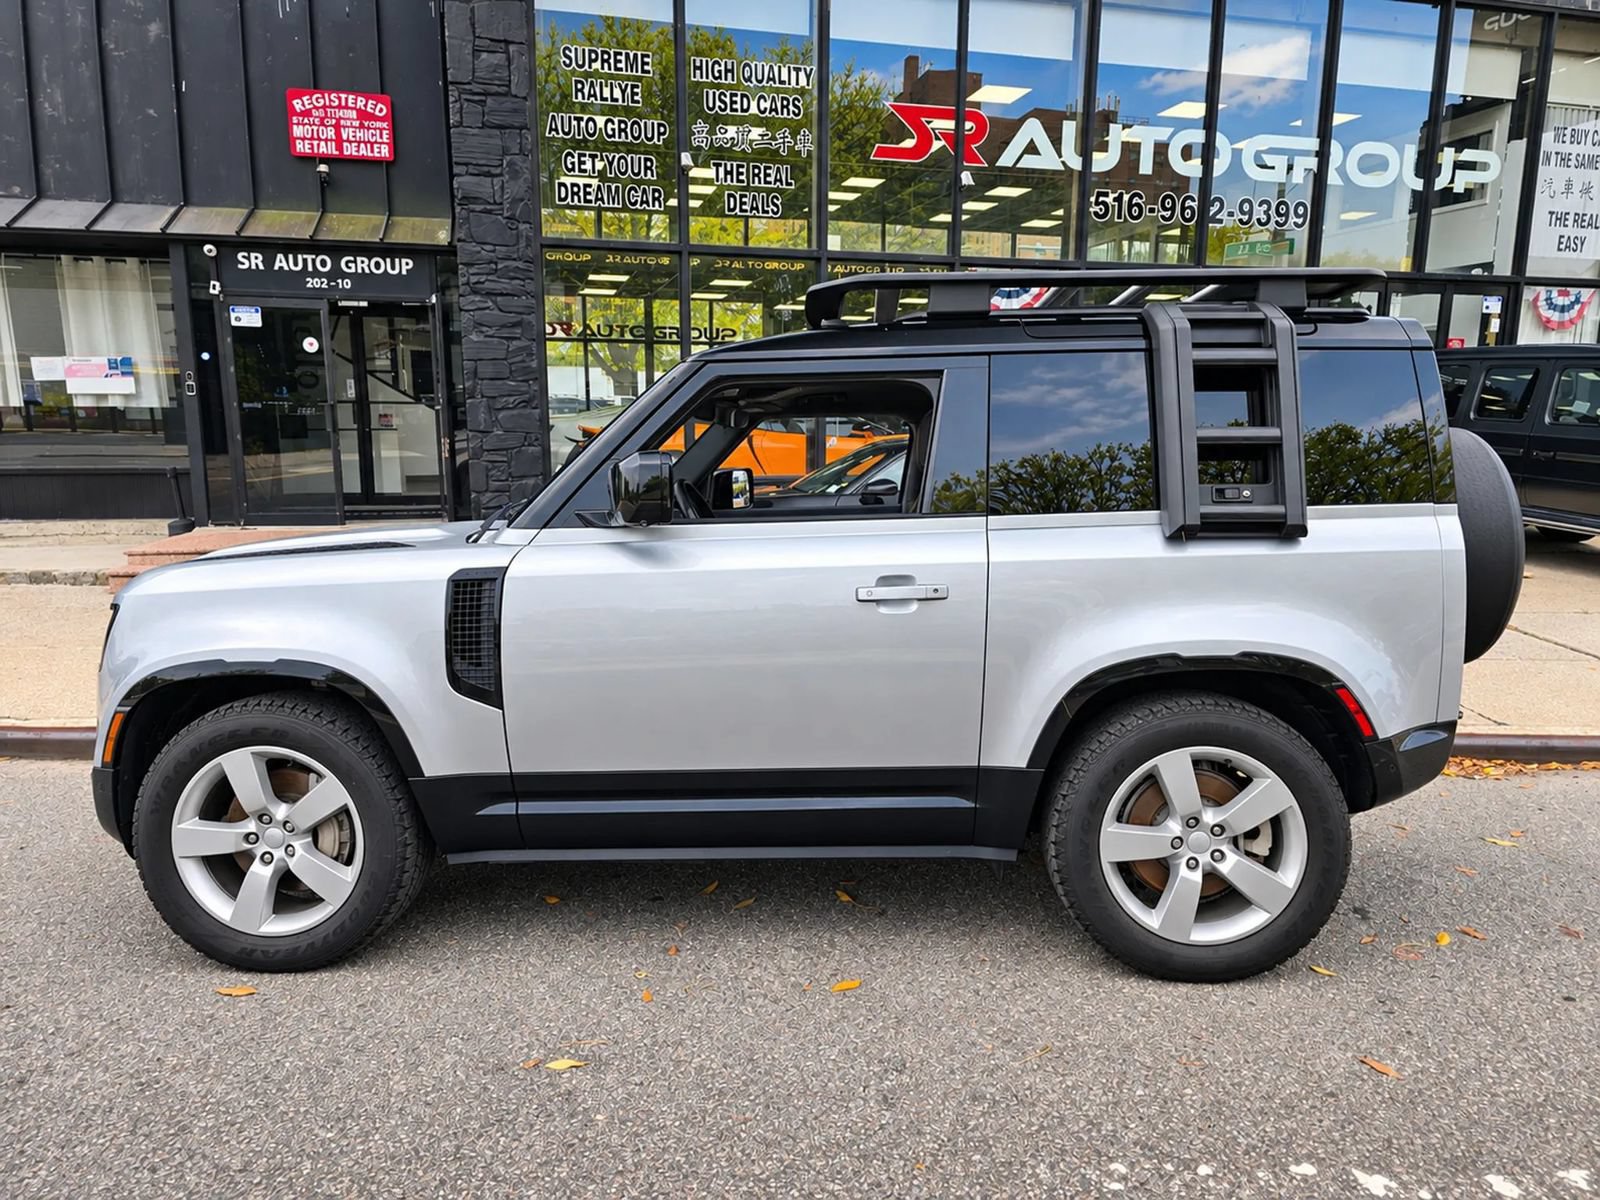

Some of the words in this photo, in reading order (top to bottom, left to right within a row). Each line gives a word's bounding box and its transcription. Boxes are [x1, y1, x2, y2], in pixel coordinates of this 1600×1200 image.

[561, 44, 653, 77] SUPREME
[691, 56, 736, 84] HIGH
[741, 60, 815, 89] QUALITY
[292, 92, 387, 117] REGISTERED
[572, 77, 642, 107] RALLYE
[704, 88, 752, 116] USED
[755, 92, 804, 120] CARS
[292, 124, 337, 140] MOTOR
[341, 127, 390, 143] VEHICLE
[546, 112, 600, 140] AUTO
[602, 116, 670, 145] GROUP
[869, 101, 990, 168] SR
[1553, 126, 1568, 144] WE
[1569, 128, 1590, 146] BUY
[295, 139, 340, 155] RETAIL
[342, 142, 390, 158] DEALER
[1541, 150, 1552, 167] IN
[1554, 151, 1573, 168] THE
[1574, 153, 1600, 170] SAME
[562, 149, 602, 176] GET
[602, 152, 657, 179] YOUR
[711, 160, 747, 186] THE
[749, 162, 796, 189] REAL
[555, 180, 623, 208] DREAM
[625, 184, 665, 211] CAR
[725, 190, 782, 218] DEALS
[1090, 189, 1311, 231] 516-962-9399
[1548, 210, 1570, 228] THE
[1572, 212, 1600, 230] REAL
[1556, 234, 1587, 254] EASY
[236, 252, 265, 271] SR
[273, 253, 332, 273] AUTO
[340, 256, 414, 276] GROUP
[305, 277, 351, 290] 202-10
